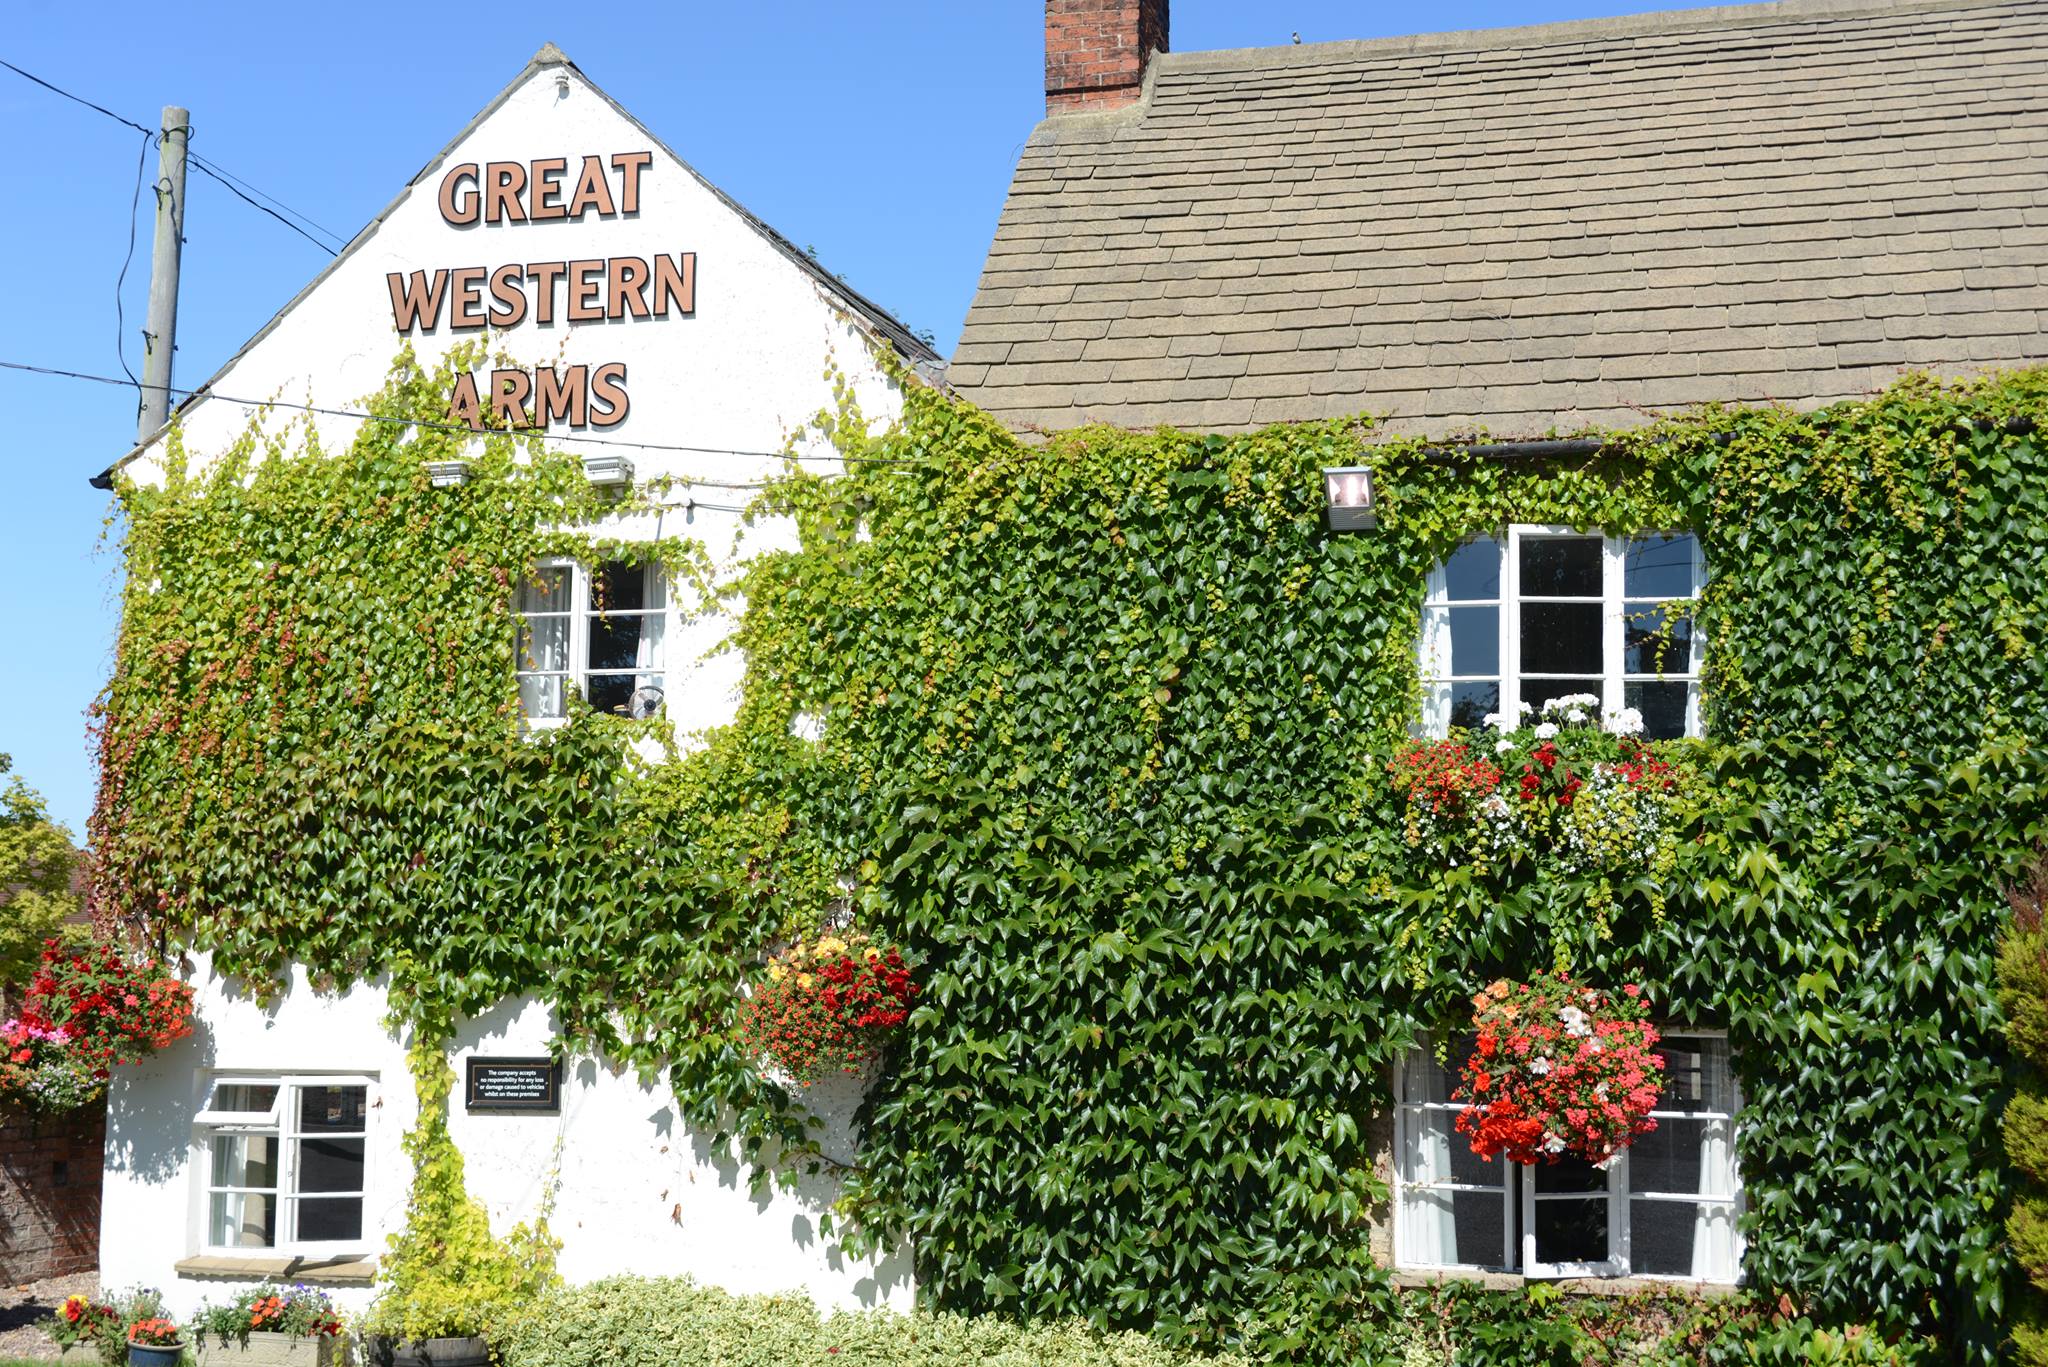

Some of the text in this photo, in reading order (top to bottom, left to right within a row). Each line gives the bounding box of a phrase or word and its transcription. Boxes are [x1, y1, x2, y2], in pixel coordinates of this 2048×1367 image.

[438, 151, 653, 225] GREAT
[386, 252, 698, 332] WESTERN
[446, 362, 631, 432] ARMS
